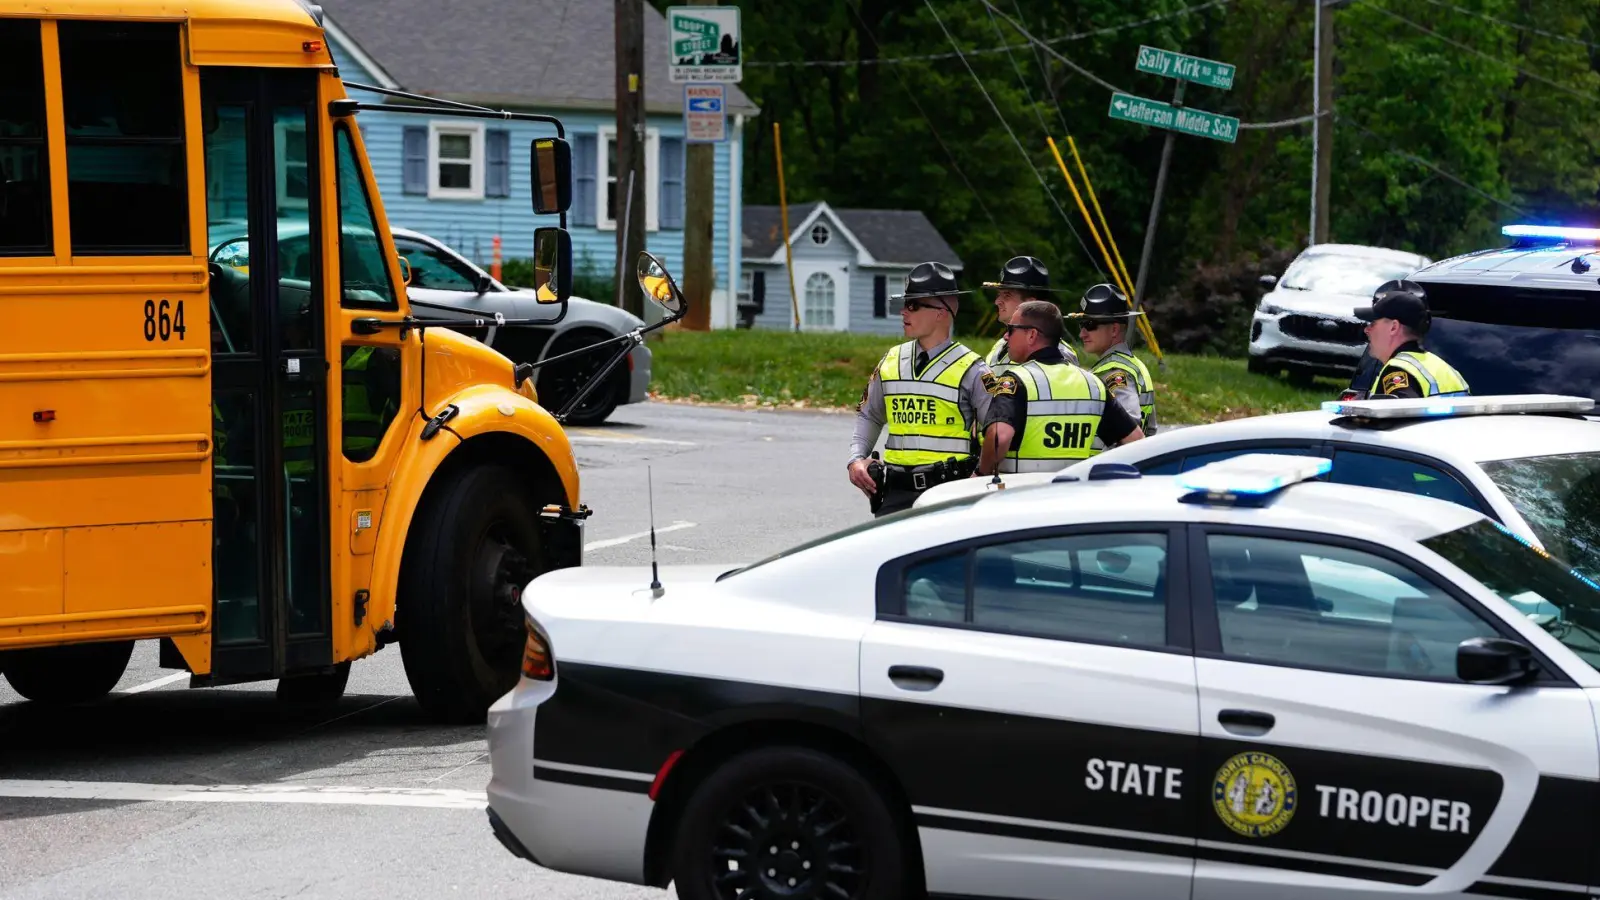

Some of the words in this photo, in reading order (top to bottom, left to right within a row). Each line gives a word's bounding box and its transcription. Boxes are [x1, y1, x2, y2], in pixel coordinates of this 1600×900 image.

[678, 19, 705, 32] ADOPT
[709, 25, 716, 34] A
[682, 39, 712, 51] STREET
[1139, 49, 1171, 74] Sally
[1173, 57, 1200, 78] Kirk
[1217, 66, 1229, 76] NW
[1211, 75, 1231, 87] 3500
[1124, 101, 1173, 125] Jefferson
[1175, 110, 1211, 133] Middle
[1212, 118, 1234, 139] Sch.
[144, 299, 186, 342] 864
[892, 397, 936, 412] STATE
[892, 411, 937, 425] TROOPER
[1043, 422, 1091, 449] SHP
[1084, 758, 1183, 800] STATE
[1217, 755, 1248, 782] NORTH
[1251, 755, 1295, 792] CAROLINA
[1315, 784, 1472, 834] TROOPER
